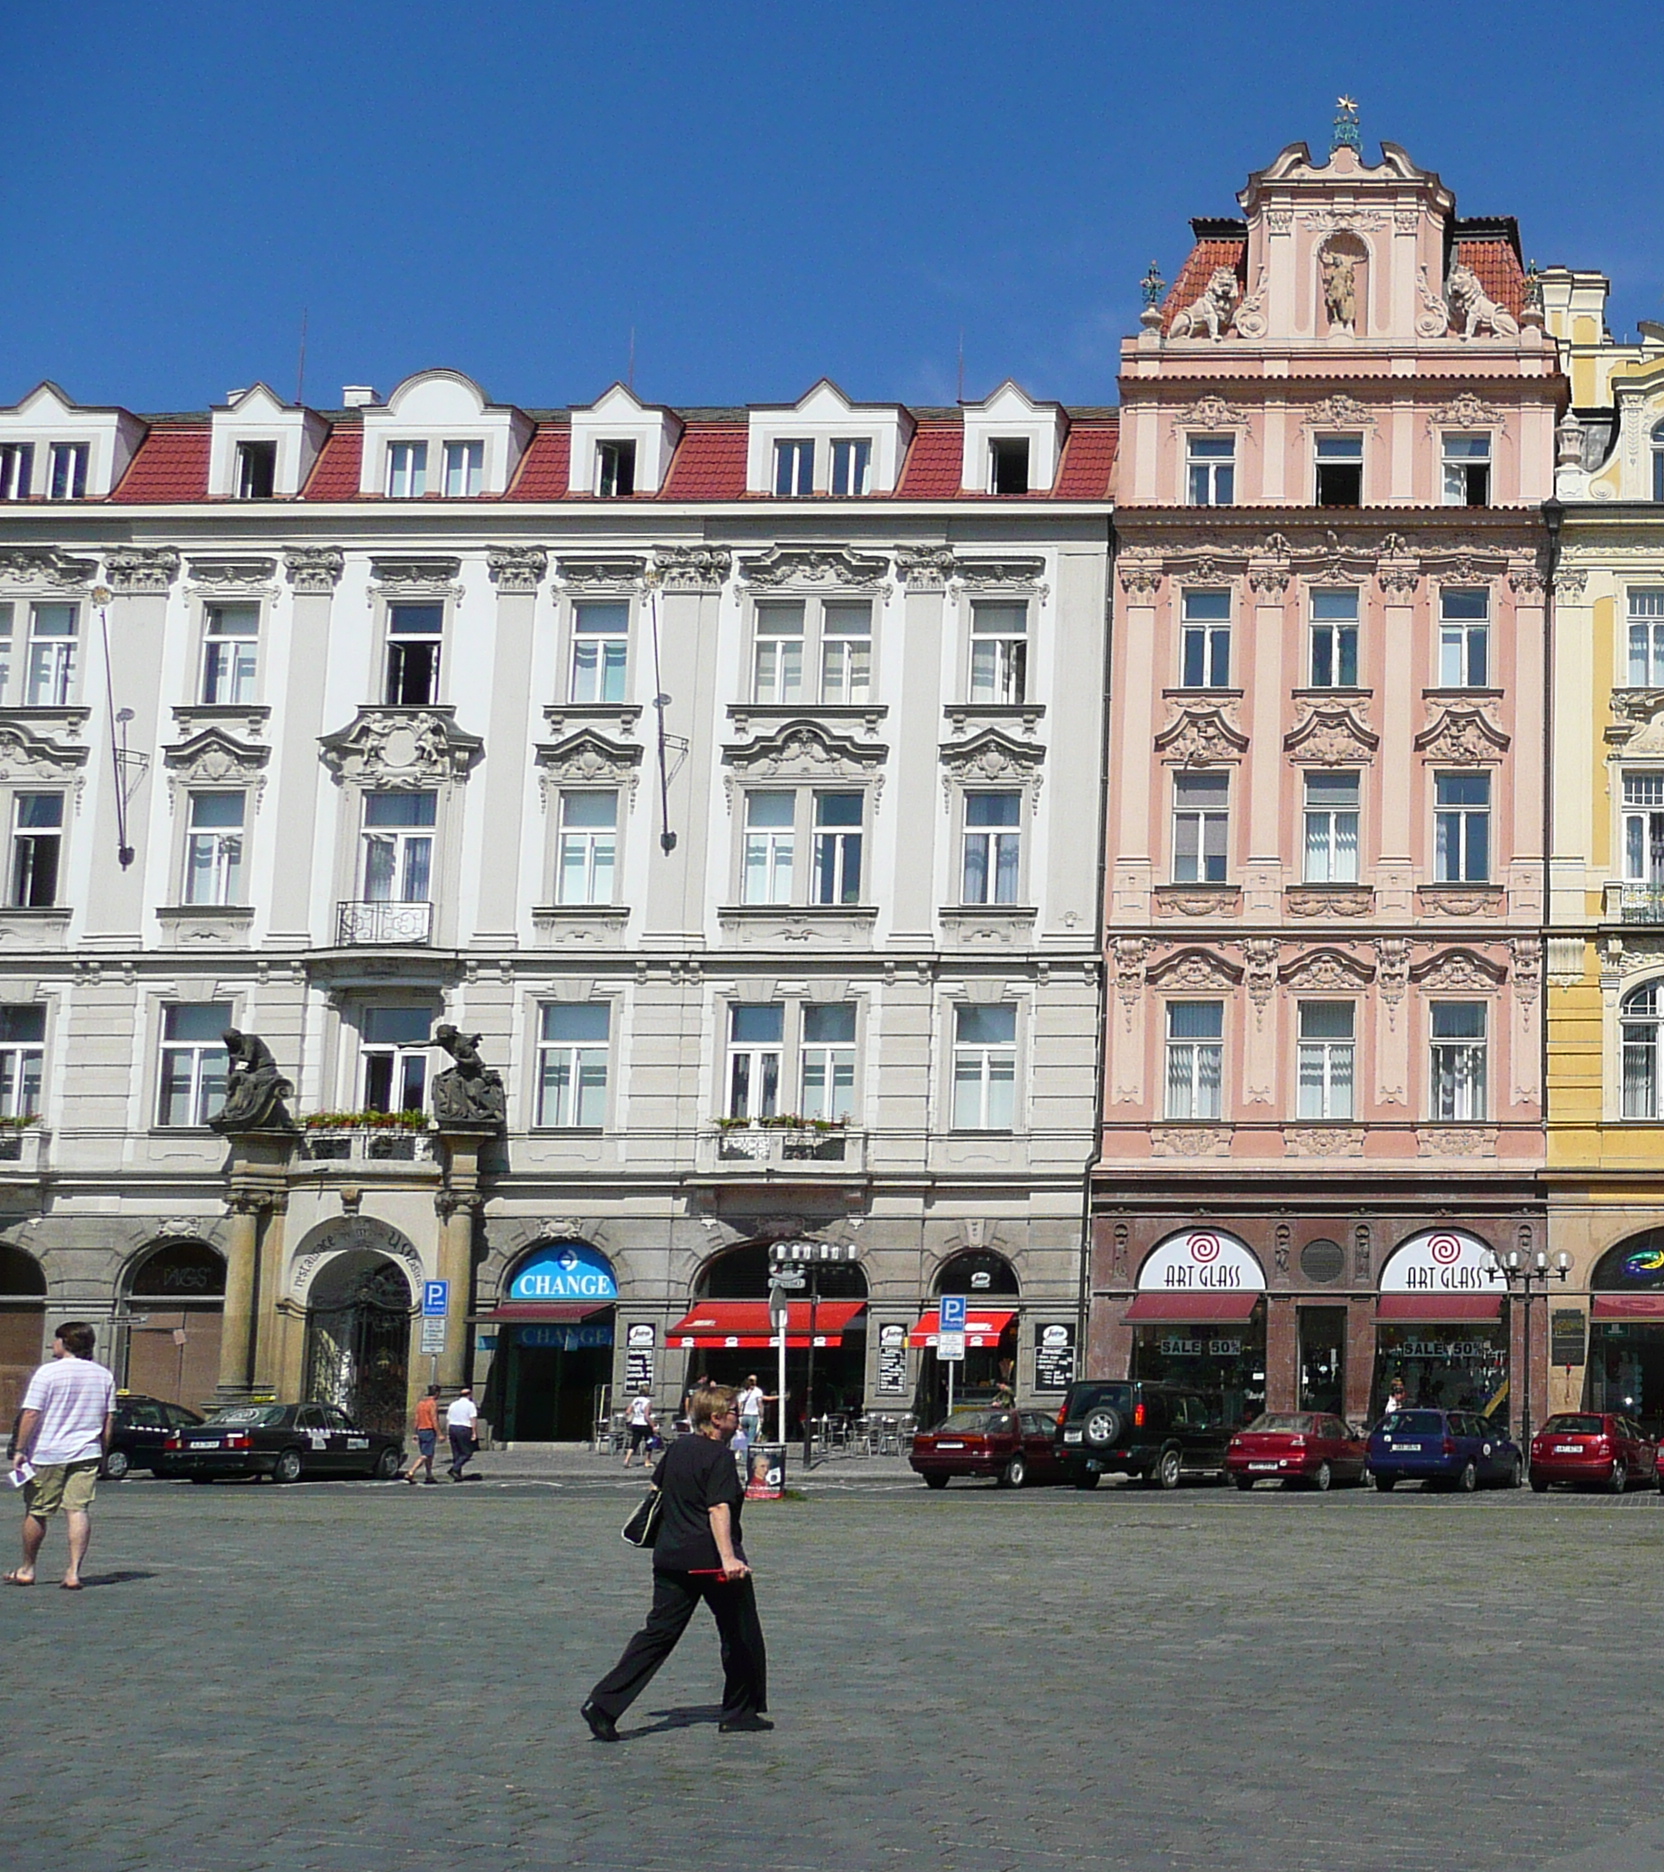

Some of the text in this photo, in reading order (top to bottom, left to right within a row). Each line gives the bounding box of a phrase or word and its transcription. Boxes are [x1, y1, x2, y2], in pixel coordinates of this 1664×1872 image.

[519, 1274, 611, 1295] CHANGE
[1164, 1264, 1241, 1287] ART GLASS
[1405, 1266, 1482, 1289] ART GLASS
[428, 1284, 444, 1305] P
[945, 1300, 960, 1321] P
[521, 1328, 608, 1344] CHANGE
[1162, 1341, 1240, 1353] SALE 50%
[1404, 1343, 1443, 1355] SALE
